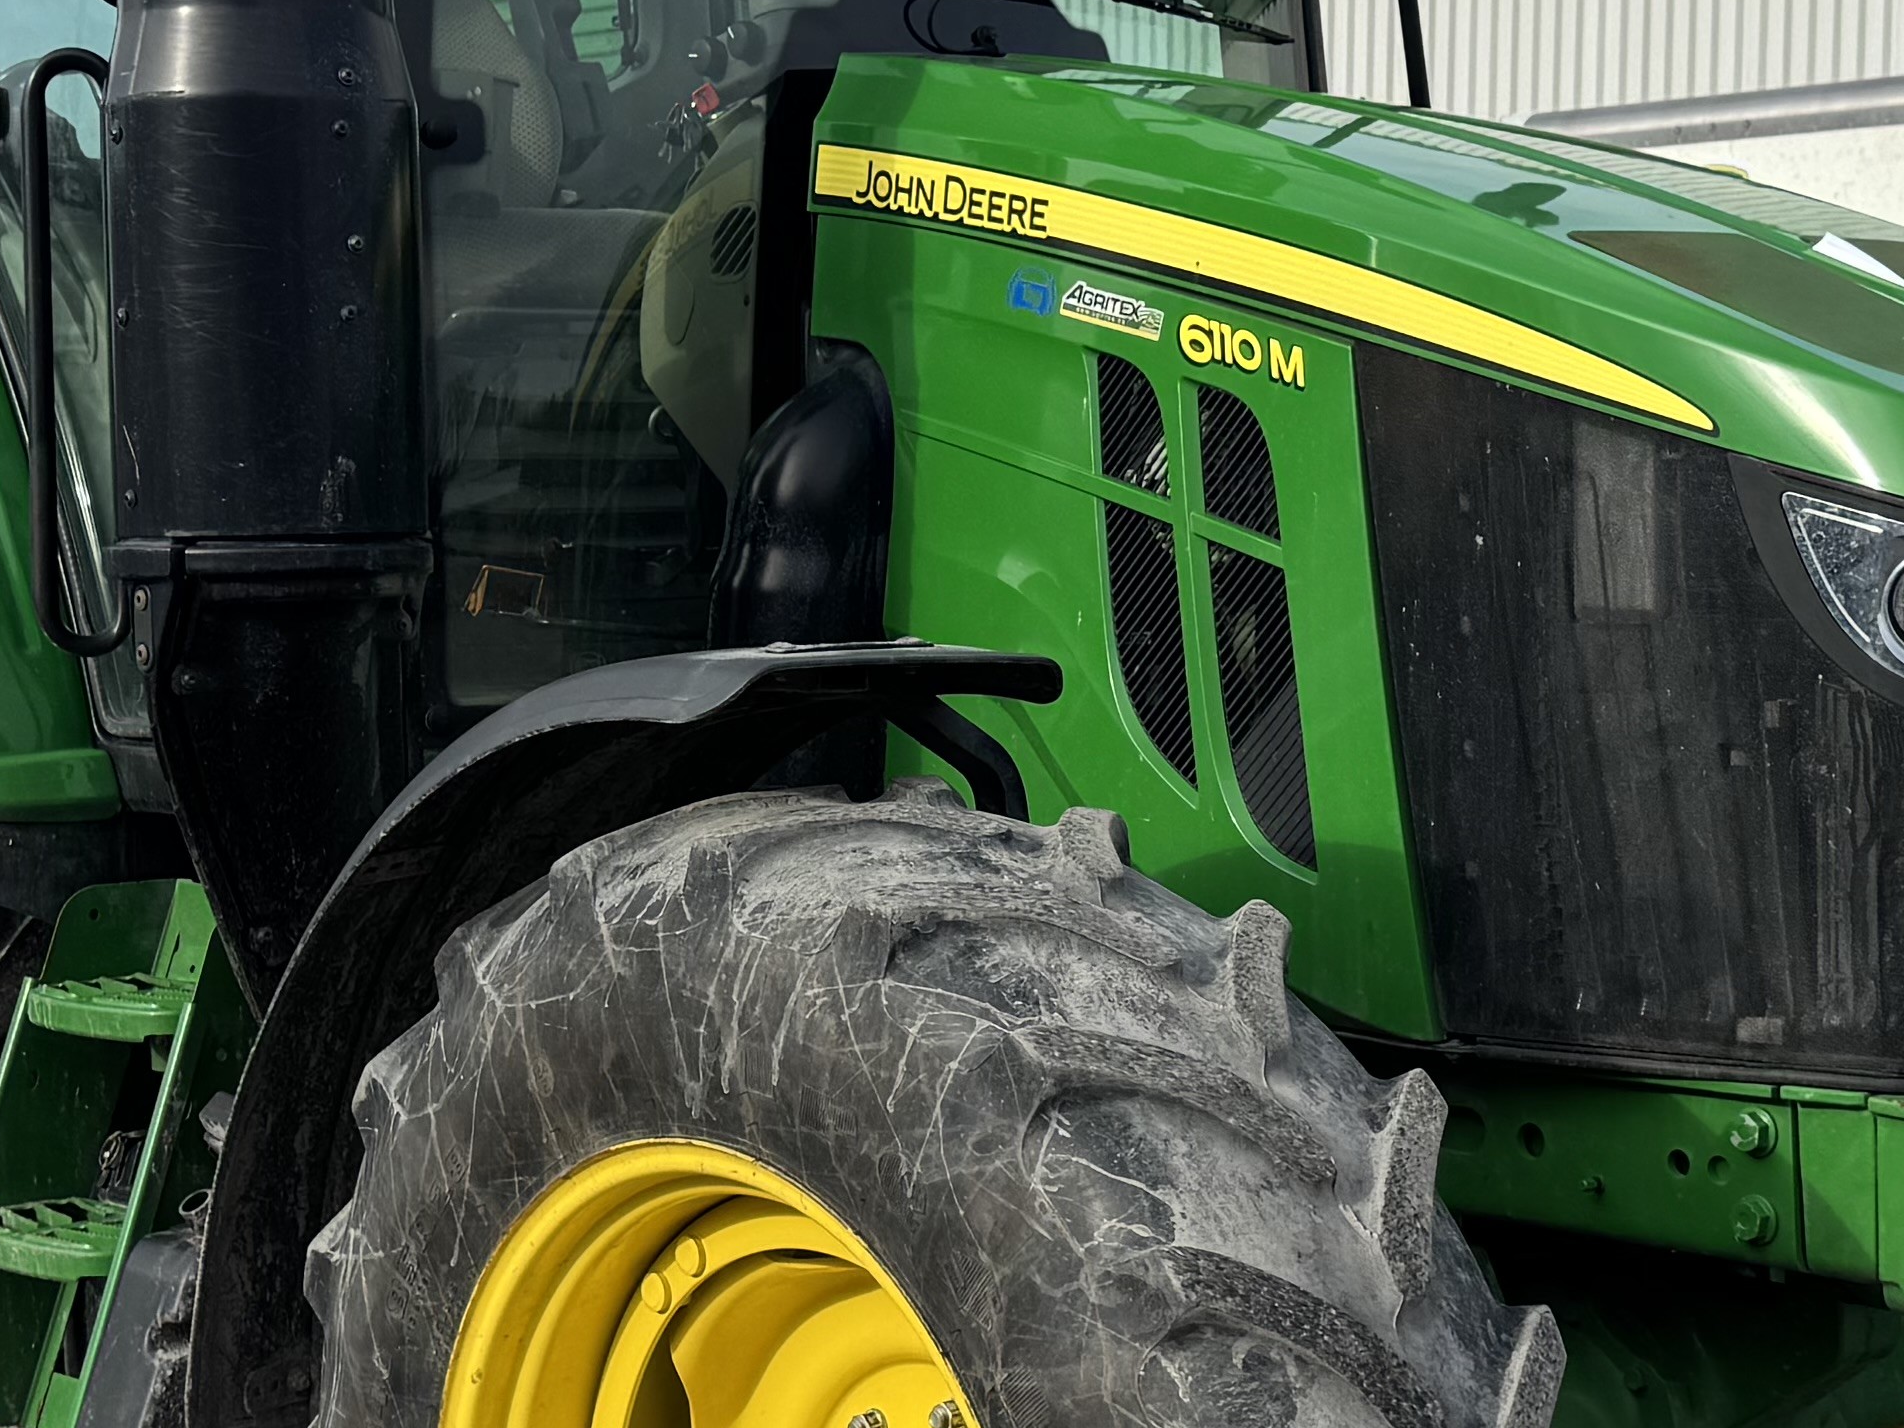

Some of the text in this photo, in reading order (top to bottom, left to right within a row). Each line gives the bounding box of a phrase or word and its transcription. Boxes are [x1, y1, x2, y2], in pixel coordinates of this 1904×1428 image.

[855, 160, 1049, 232] JOHN DEERE
[1065, 284, 1142, 320] AGRITEX
[1178, 314, 1306, 390] 6110 M
